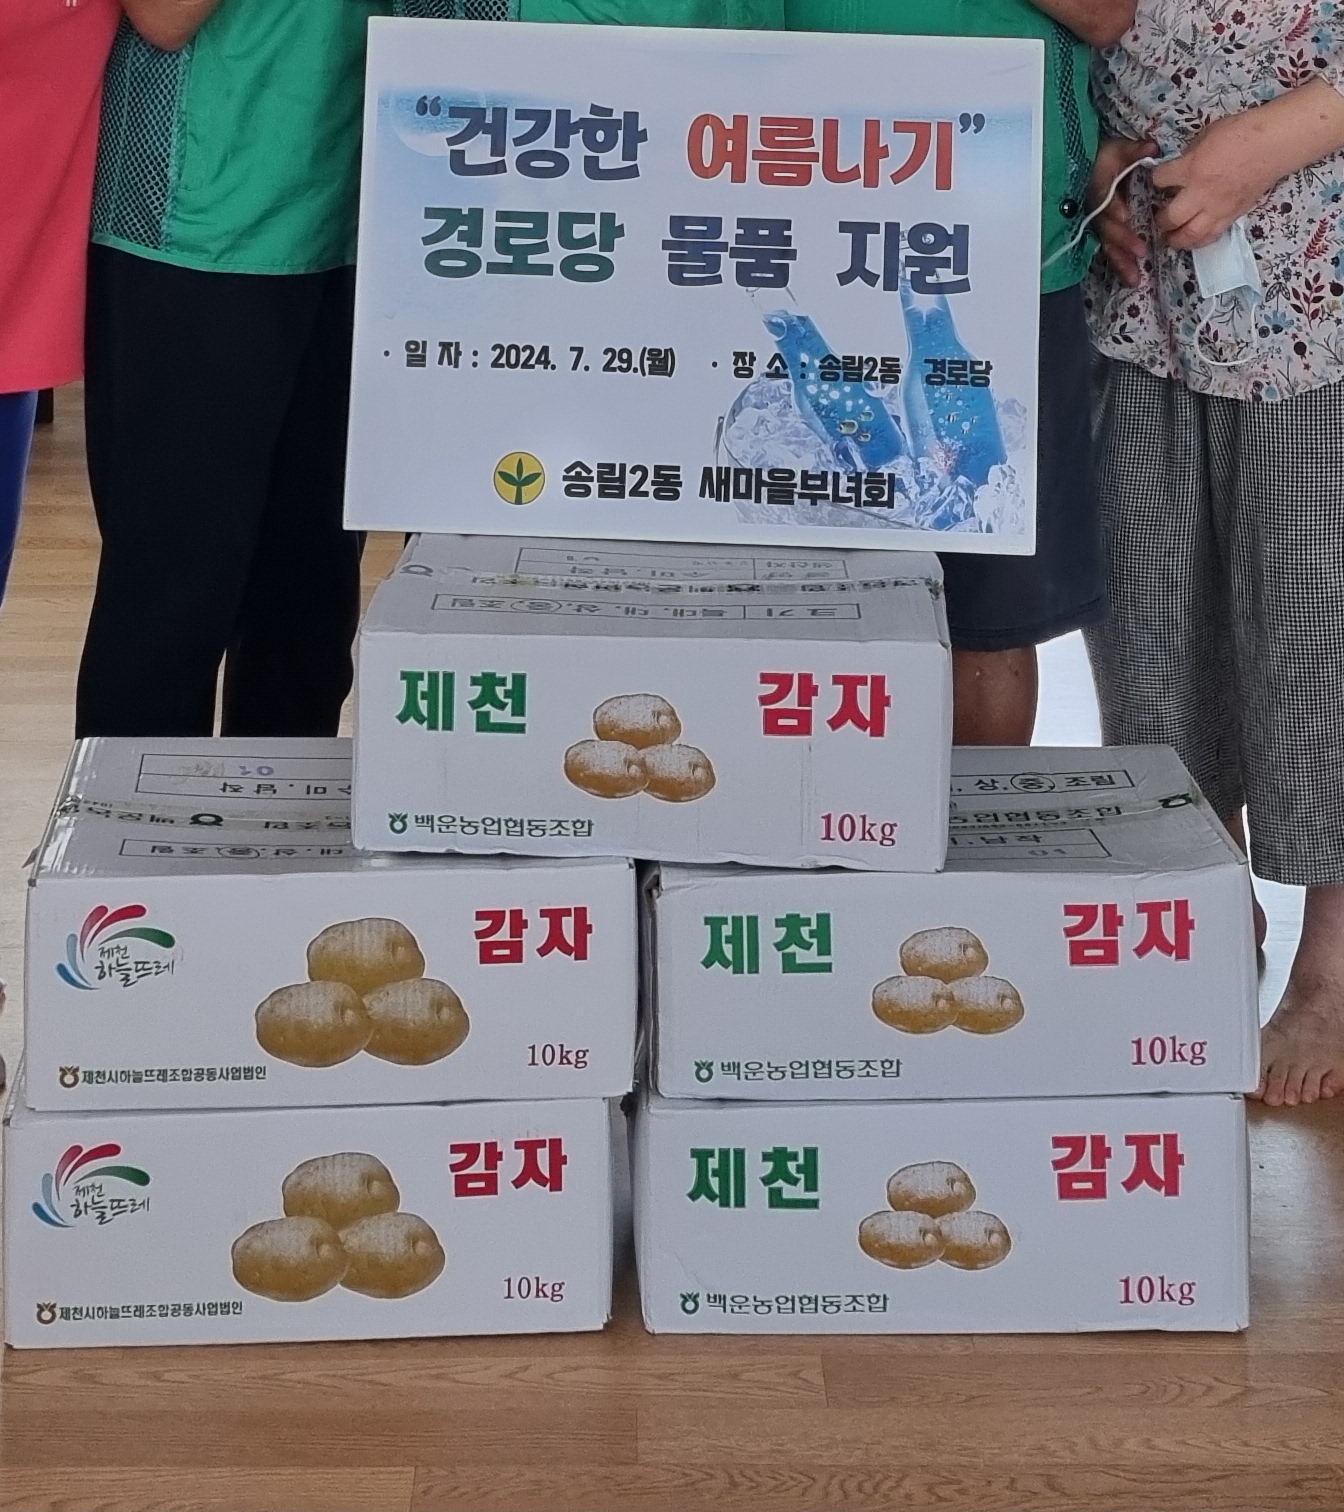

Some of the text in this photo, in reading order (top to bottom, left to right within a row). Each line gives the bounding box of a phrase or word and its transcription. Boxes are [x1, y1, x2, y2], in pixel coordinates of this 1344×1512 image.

[421, 206, 971, 296] 경로당 물품 지원
[602, 348, 676, 378] 29.(월)
[818, 354, 903, 384] 송림2동
[925, 358, 993, 387] 경로당
[561, 461, 896, 510] 송림2동 새마을부녀회
[395, 670, 892, 738] 제천 감자
[1065, 775, 1116, 787] 조림
[414, 813, 899, 847] 백운농업협동조합 10kg
[98, 944, 130, 961] 제천
[473, 906, 594, 964] 감자
[701, 899, 1197, 975] 제천 감자
[94, 957, 175, 988] 하늘뜨레
[527, 1043, 590, 1070] 10kg
[721, 1035, 1208, 1082] 백운농업협동조합 10kg
[82, 1065, 267, 1086] 제천시하늘뜨레조합공동사업법인
[449, 1137, 568, 1198] 감자
[686, 1133, 1185, 1209] 제천 감자
[73, 1182, 104, 1200] 제천
[69, 1196, 151, 1226] 하늘뜨레
[502, 1276, 566, 1303] 10kg
[706, 1276, 1197, 1316] 백운농업협동조합 10kg
[58, 1301, 244, 1322] 제천시하늘뜨레조합공동사업법인
